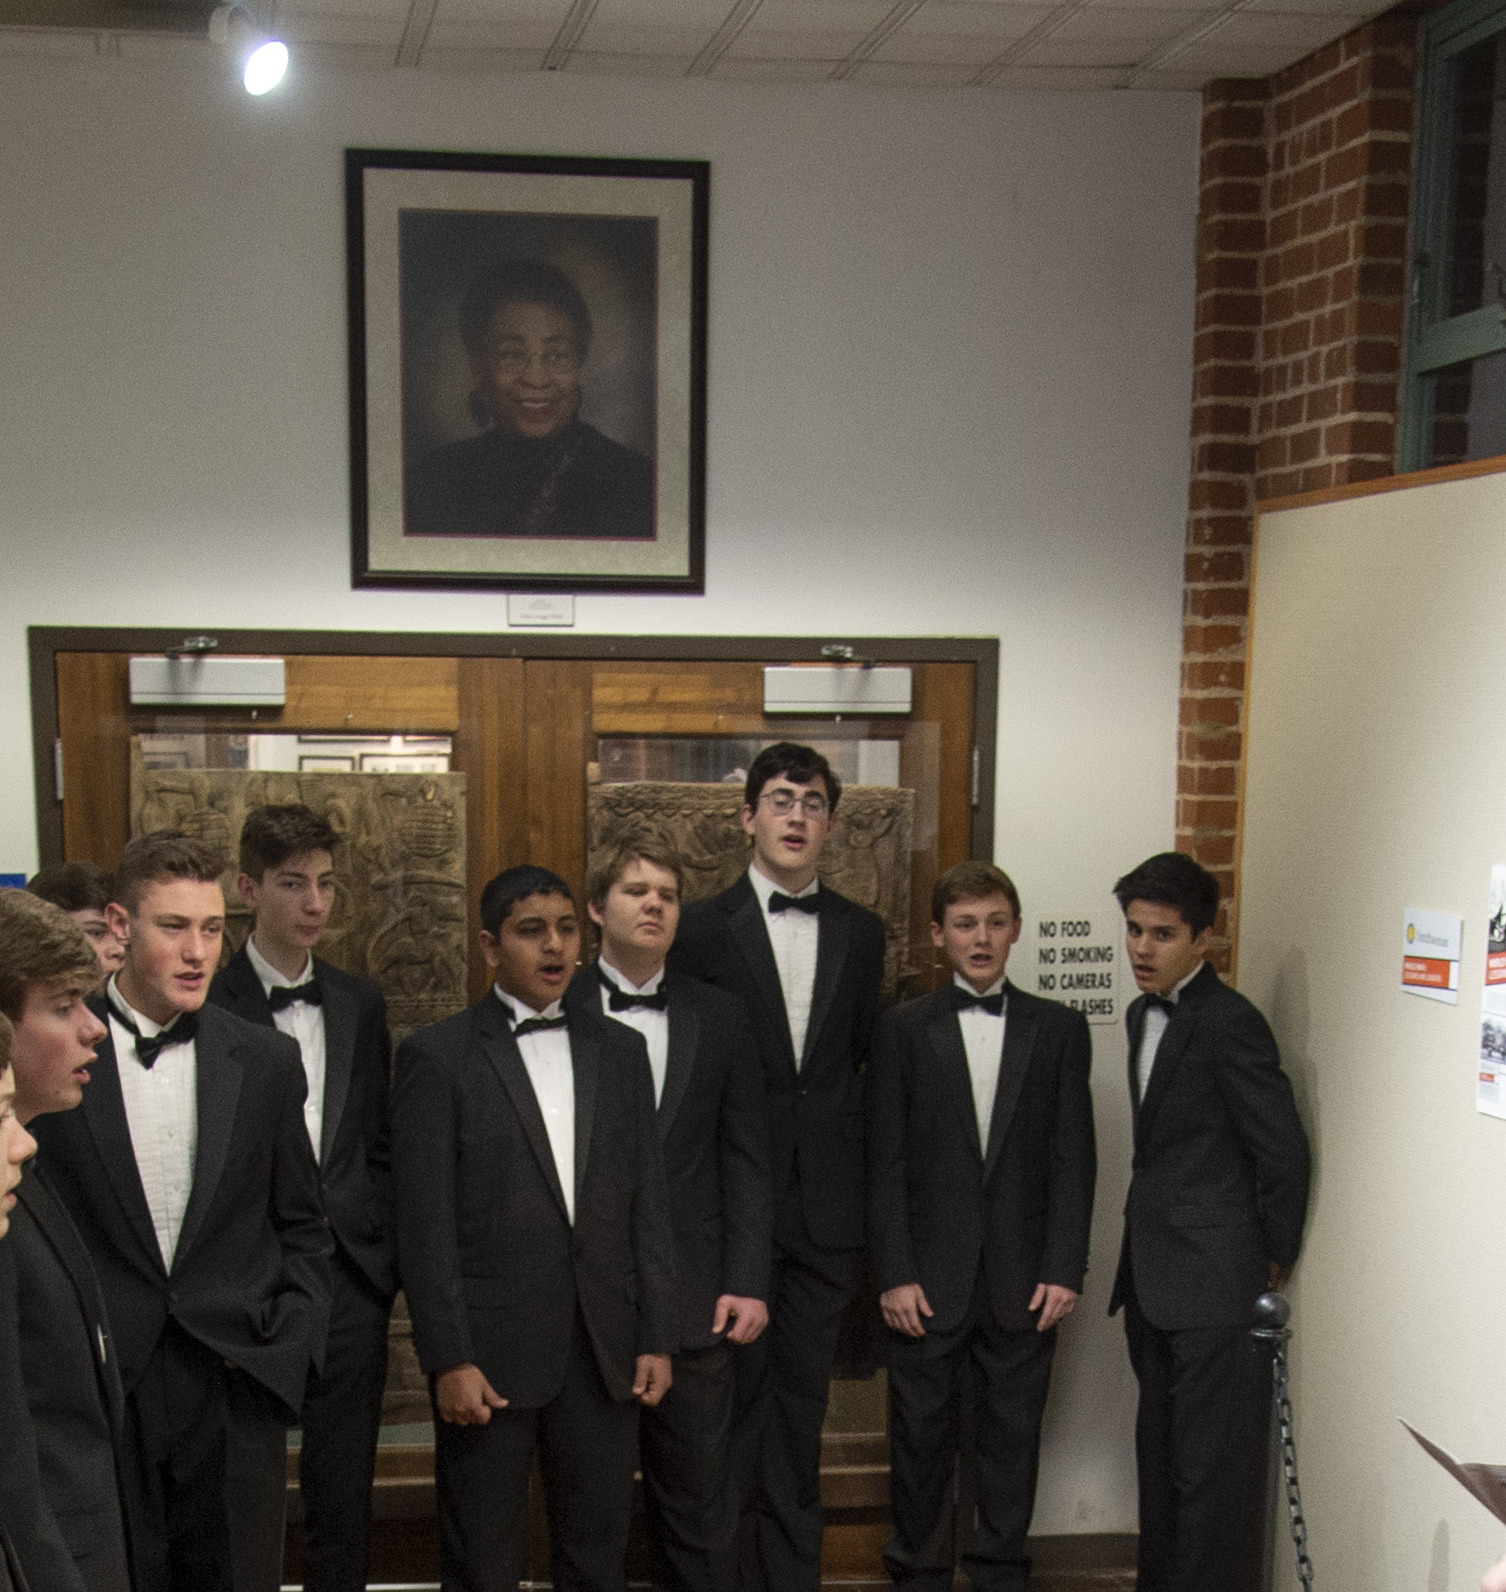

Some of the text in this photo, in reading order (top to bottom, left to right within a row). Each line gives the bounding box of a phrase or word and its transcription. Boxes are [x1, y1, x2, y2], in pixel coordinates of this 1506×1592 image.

[1039, 920, 1091, 937] NO FOOD
[1039, 947, 1113, 964] NO SMOKING
[1038, 973, 1112, 990] NO CAMERAS
